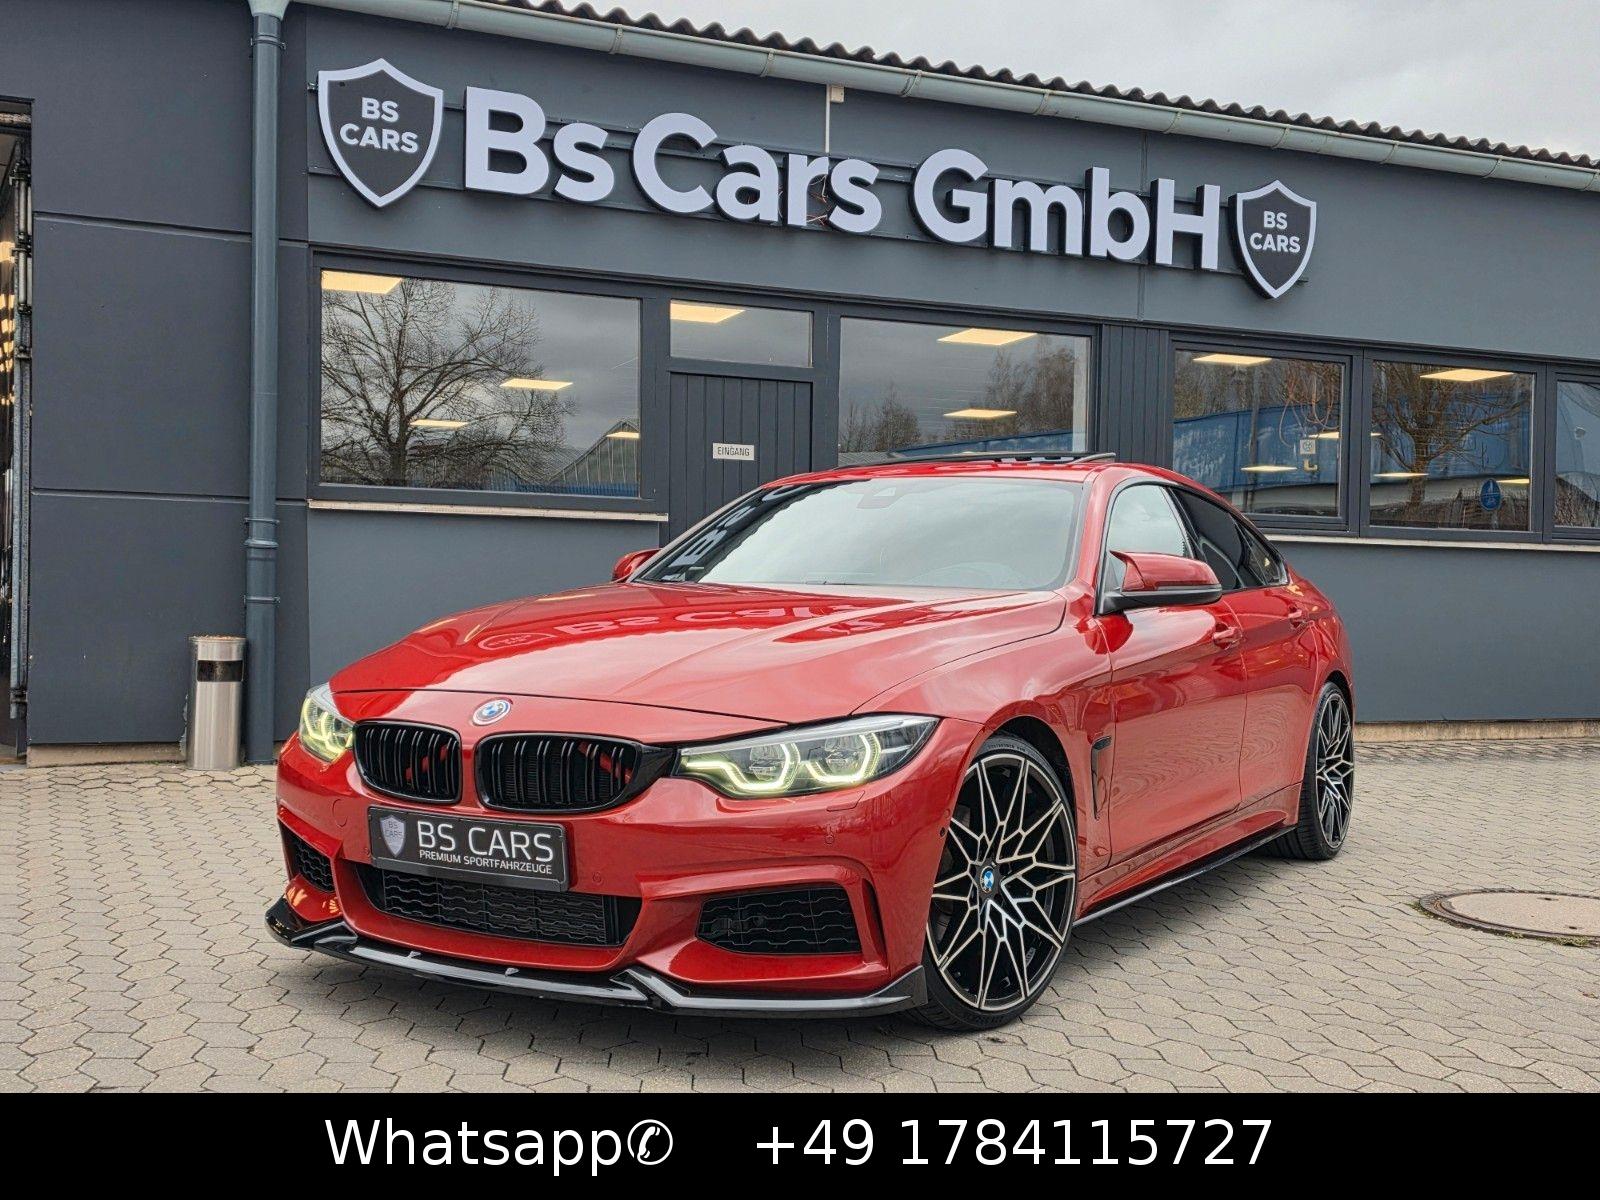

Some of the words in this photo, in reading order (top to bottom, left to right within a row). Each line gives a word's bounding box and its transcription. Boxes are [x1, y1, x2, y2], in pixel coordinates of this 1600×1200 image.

[361, 96, 399, 122] BS
[339, 123, 419, 153] CARS
[465, 85, 615, 202] Bs
[632, 112, 883, 234] Cars
[912, 148, 1220, 271] GmbH
[1263, 210, 1288, 230] BS
[1249, 232, 1301, 253] CARS
[717, 446, 750, 457] EINGANG
[417, 820, 456, 851] BS
[467, 826, 554, 863] CARS
[419, 849, 462, 864] PREMIUM
[463, 855, 553, 875] SPORTFAHRZEUGE
